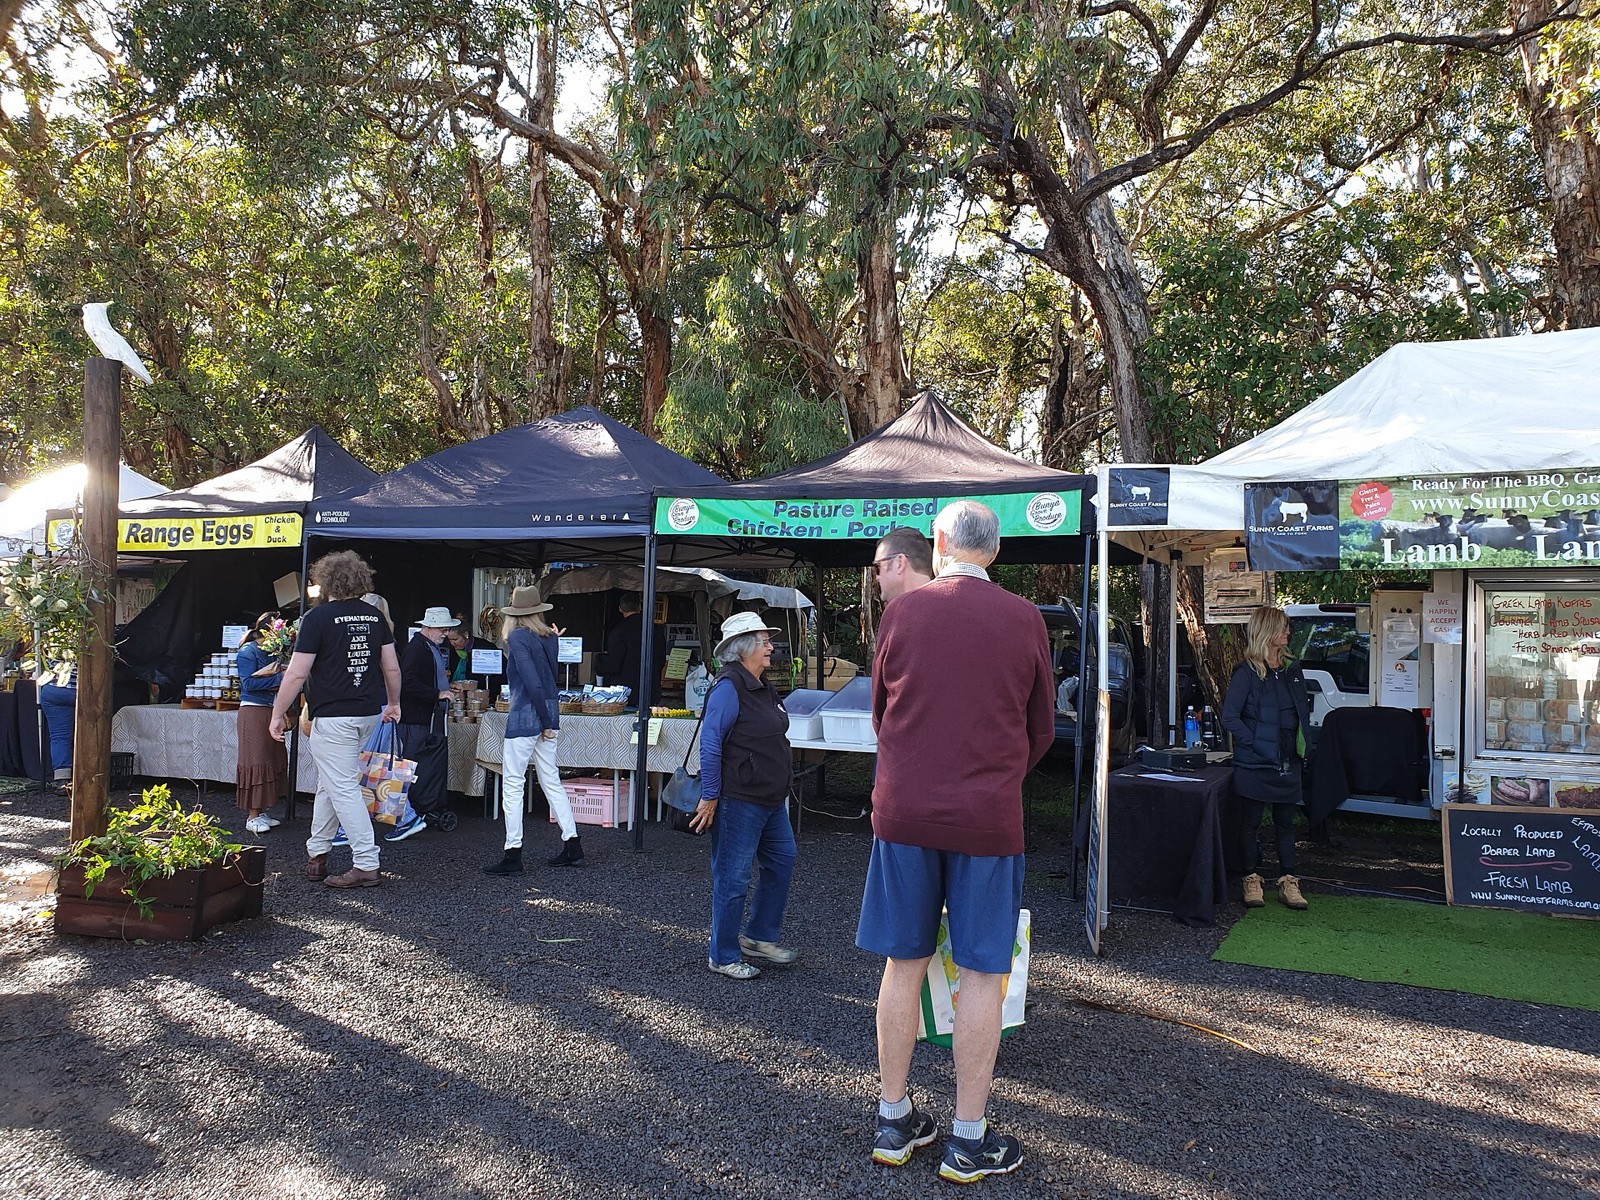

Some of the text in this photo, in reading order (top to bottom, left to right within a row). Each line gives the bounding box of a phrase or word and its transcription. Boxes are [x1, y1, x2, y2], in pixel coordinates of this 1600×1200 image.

[1412, 478, 1456, 492] Ready
[1461, 477, 1487, 489] For
[1491, 476, 1521, 488] The
[1525, 473, 1569, 487] BBQ,
[1358, 487, 1378, 496] Gluten
[773, 498, 938, 518] Pasture Raised
[1363, 506, 1387, 517] Friendly
[264, 516, 296, 524] Chicken
[532, 513, 617, 522] Wanderer
[125, 520, 254, 547] Range Eggs
[274, 526, 281, 534] &
[727, 518, 822, 537] Chicken
[1306, 524, 1334, 532] FARMS
[267, 535, 287, 544] Duck
[1380, 536, 1482, 564] Lamb
[1492, 595, 1525, 609] GREEK
[1528, 595, 1553, 610] LAMB
[1461, 823, 1564, 840] LOCALLY PRODUCED
[1481, 844, 1556, 858] DORPER LAMB
[1483, 871, 1573, 894] FRESH LAMB
